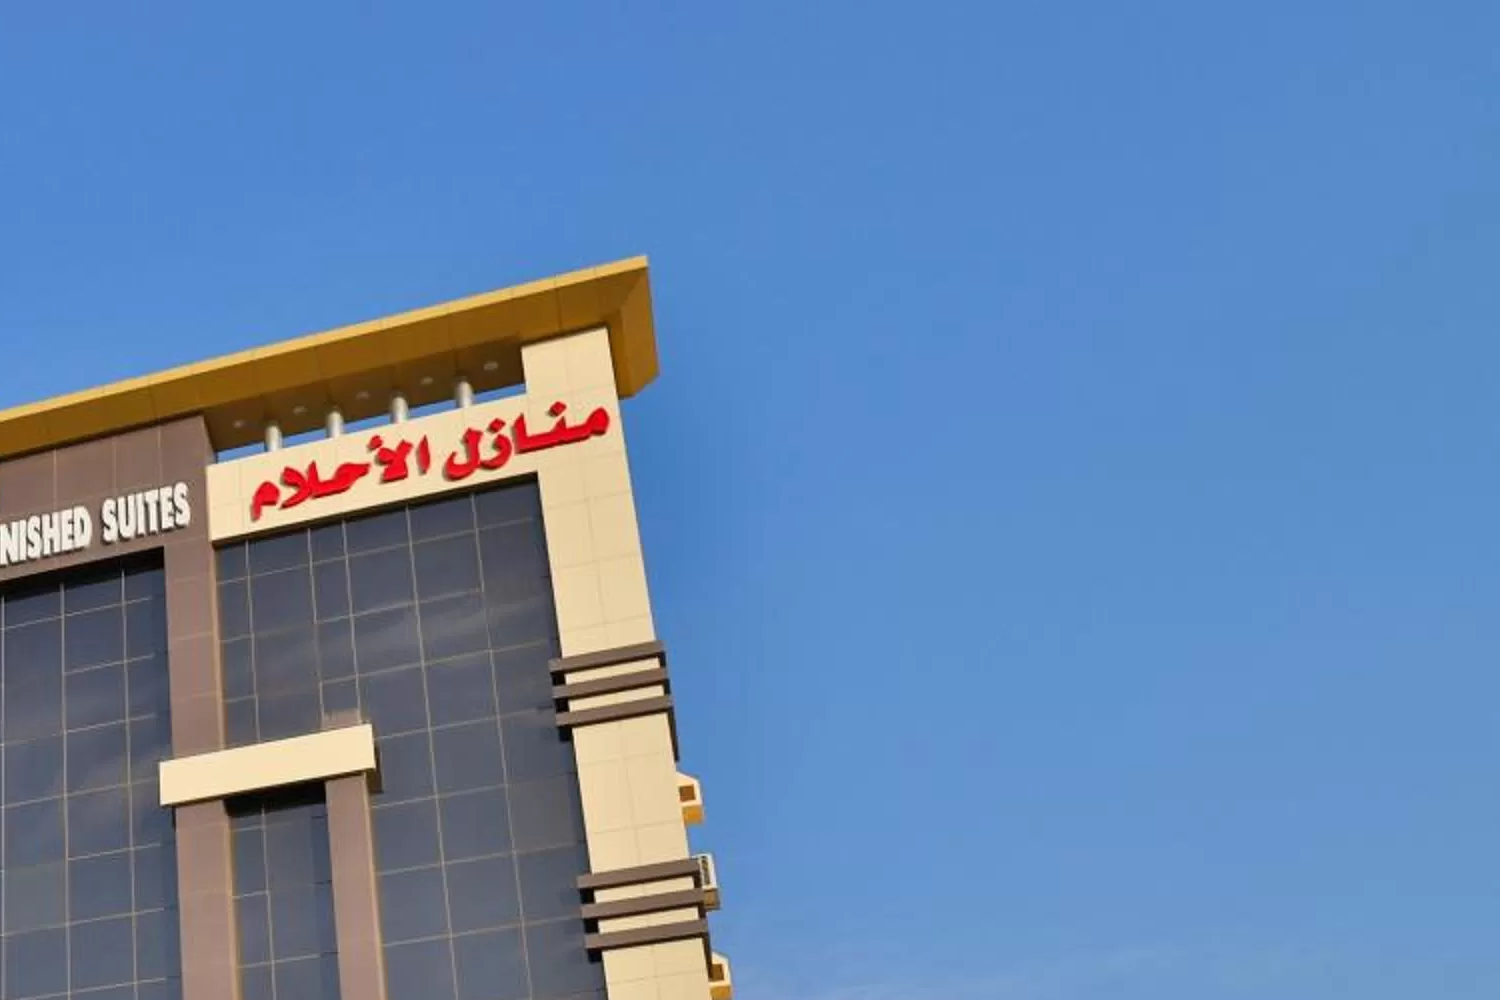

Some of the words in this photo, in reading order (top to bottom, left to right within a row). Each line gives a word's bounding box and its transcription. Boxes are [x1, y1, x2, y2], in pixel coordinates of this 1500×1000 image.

[251, 434, 431, 521] الأحلام
[444, 401, 610, 481] منازل
[101, 482, 192, 543] SUITES
